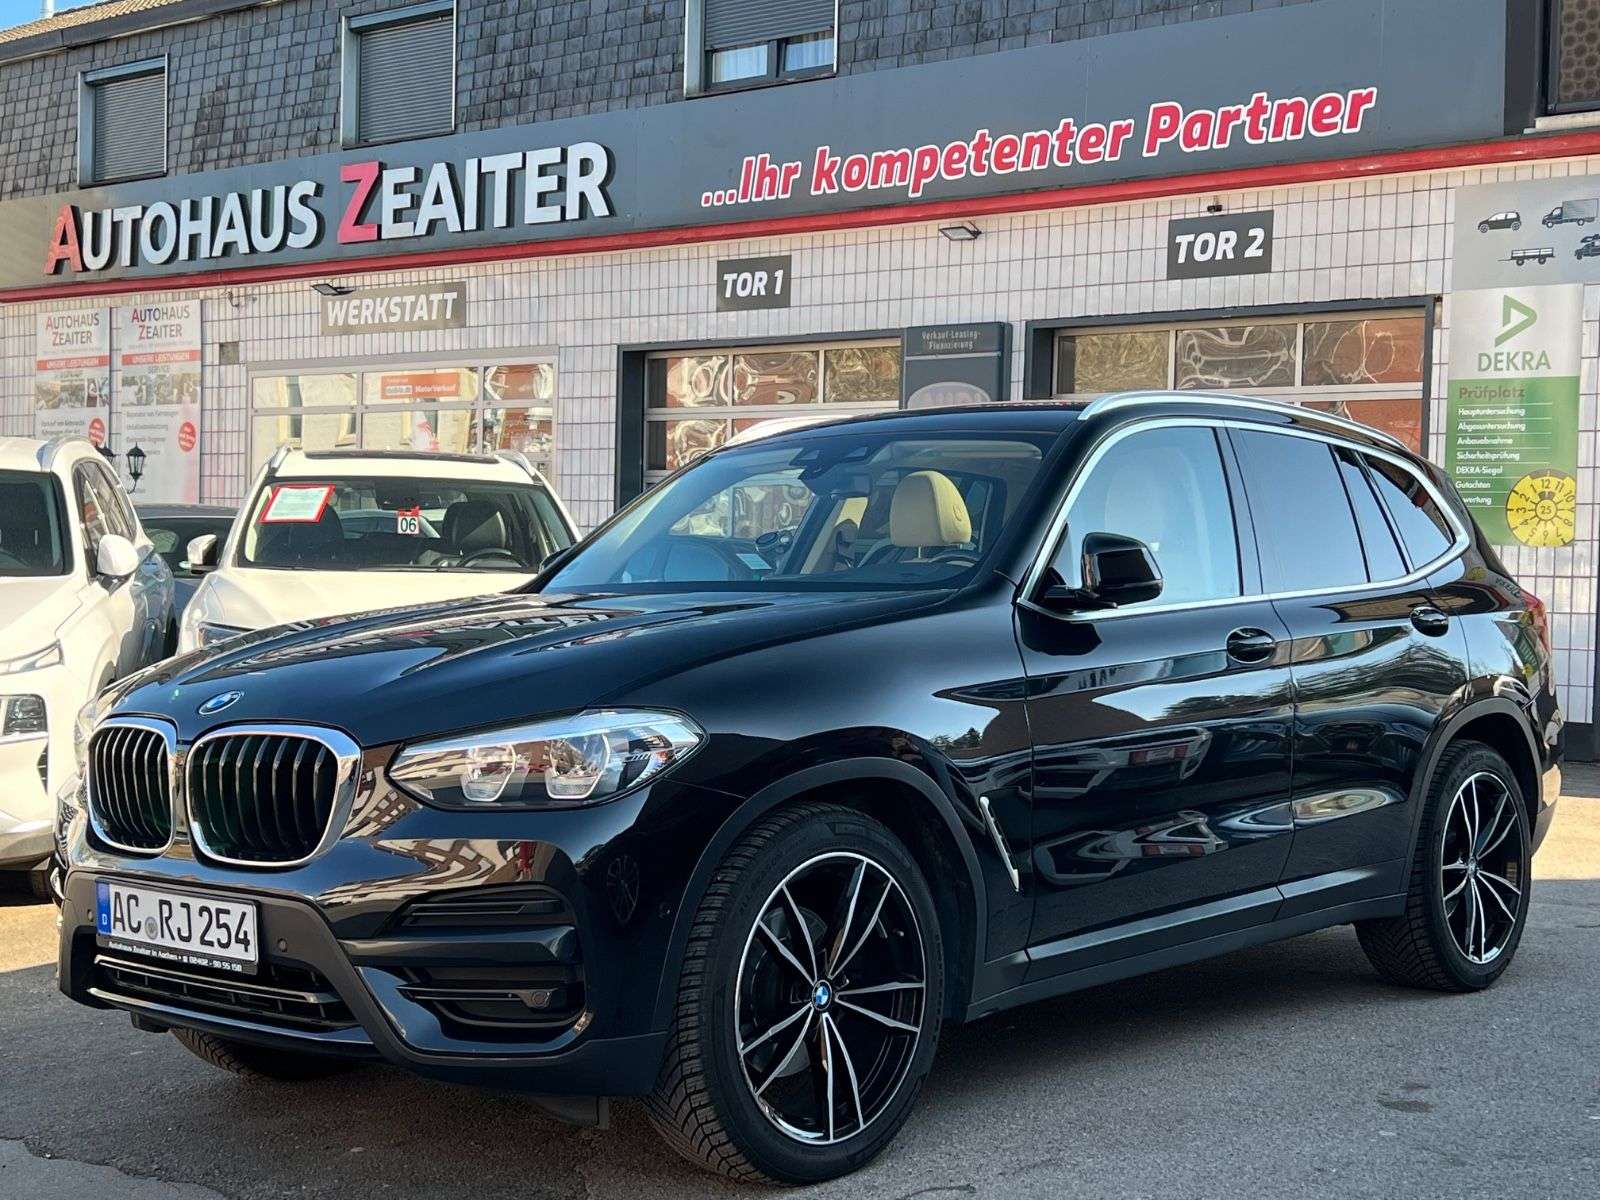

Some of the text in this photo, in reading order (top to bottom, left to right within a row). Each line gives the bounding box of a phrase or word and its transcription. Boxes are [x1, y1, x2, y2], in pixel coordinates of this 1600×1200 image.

[701, 86, 1378, 207] ...Ihr kompetenter Partner
[43, 141, 611, 275] AUTOHAUS ZEAITER
[1175, 227, 1265, 264] TOR 2
[723, 269, 784, 298] TOR 1
[131, 304, 190, 323] AUTOHAUS
[327, 292, 458, 327] WERKSTATT
[45, 312, 100, 330] AUTOHAUS
[52, 331, 93, 347] ZEAITER
[138, 323, 183, 341] ZEAITER
[1477, 350, 1552, 372] DEKRA
[1459, 385, 1526, 401] Prüfplatz
[1458, 406, 1526, 417] Hauptuntersuchung
[1457, 422, 1526, 432] Abgasuntersuchung
[1456, 466, 1503, 476] DEKRA-Siegel
[1455, 481, 1491, 489] Gutachten
[1541, 478, 1551, 489] 12
[1562, 489, 1577, 503] 10
[1541, 505, 1553, 515] 25
[400, 517, 417, 533] 06
[102, 891, 251, 953] D AC RJ 254
